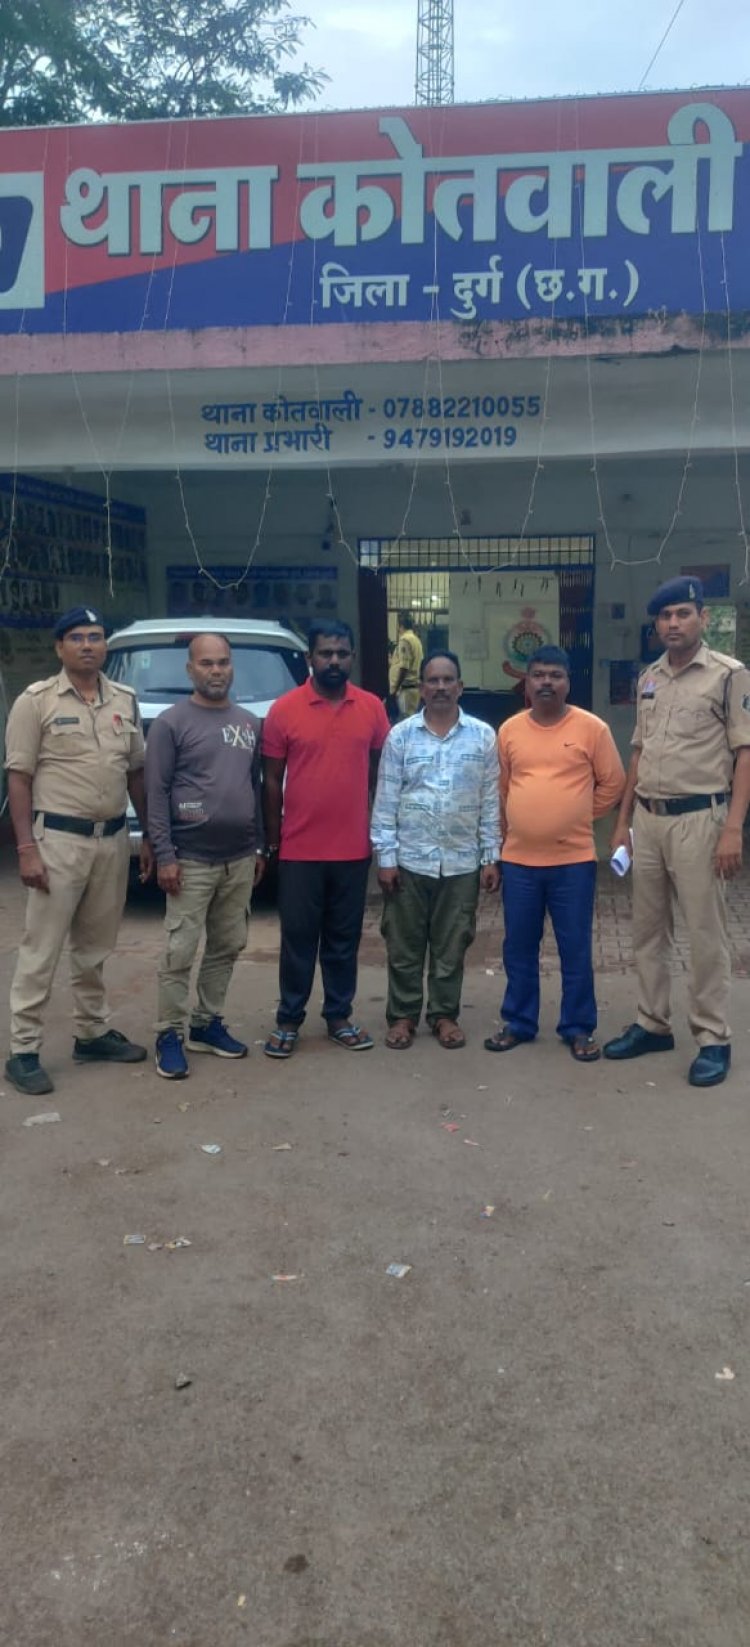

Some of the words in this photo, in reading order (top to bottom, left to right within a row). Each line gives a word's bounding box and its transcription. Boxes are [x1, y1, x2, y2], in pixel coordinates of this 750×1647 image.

[60, 165, 279, 257] थाना
[297, 102, 744, 246] कोतवाली
[320, 262, 410, 308] जिला
[451, 255, 504, 320] दुर्ग
[517, 259, 640, 309] (छ.ग.)
[201, 403, 257, 425] थाना
[262, 389, 363, 424] कोतवाली
[383, 395, 541, 420] 07882210055
[204, 431, 258, 454] थाना
[383, 426, 517, 449] 9479192019
